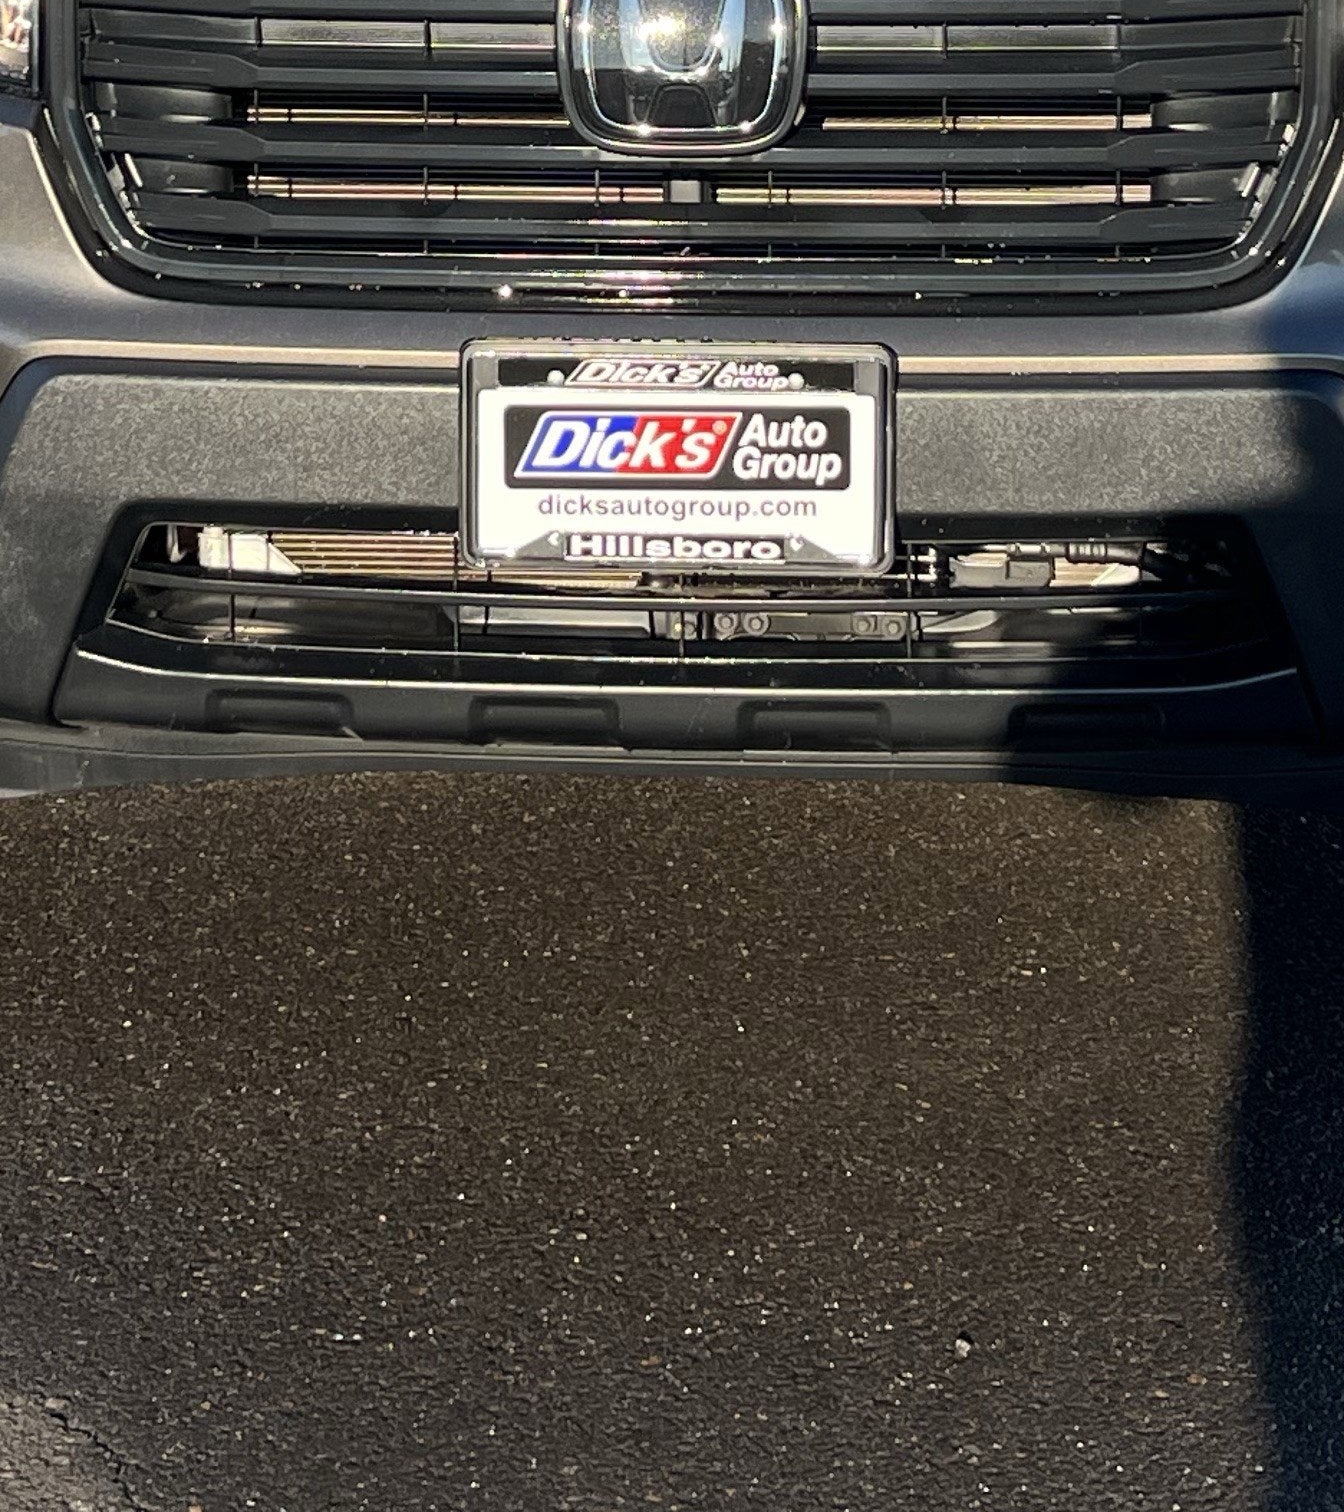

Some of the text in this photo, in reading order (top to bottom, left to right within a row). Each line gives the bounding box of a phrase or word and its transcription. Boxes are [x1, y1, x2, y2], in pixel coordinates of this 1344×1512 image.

[574, 361, 707, 385] Dick's
[713, 373, 789, 391] Group
[720, 361, 779, 377] Auto
[531, 418, 717, 469] Dick's
[738, 413, 827, 448] Auto
[733, 445, 842, 486] Group
[538, 494, 817, 521] dicksautogroup.com
[570, 534, 782, 560] Hillsboro
